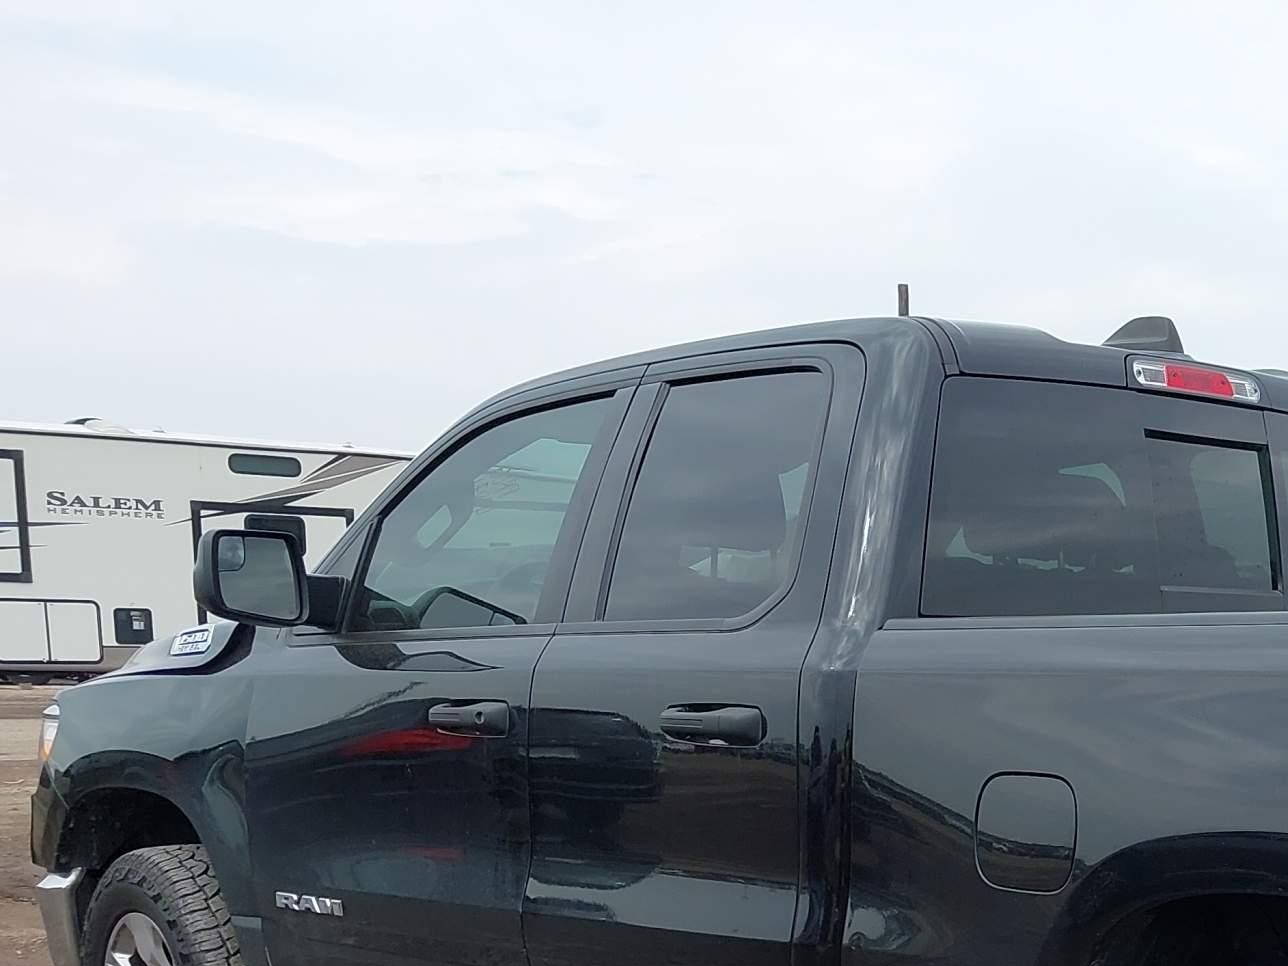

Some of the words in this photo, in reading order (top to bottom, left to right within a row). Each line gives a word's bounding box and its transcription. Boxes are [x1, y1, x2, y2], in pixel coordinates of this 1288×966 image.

[46, 490, 165, 512] SALEM
[47, 507, 165, 519] HEMISPHERE
[275, 891, 344, 917] RAM
